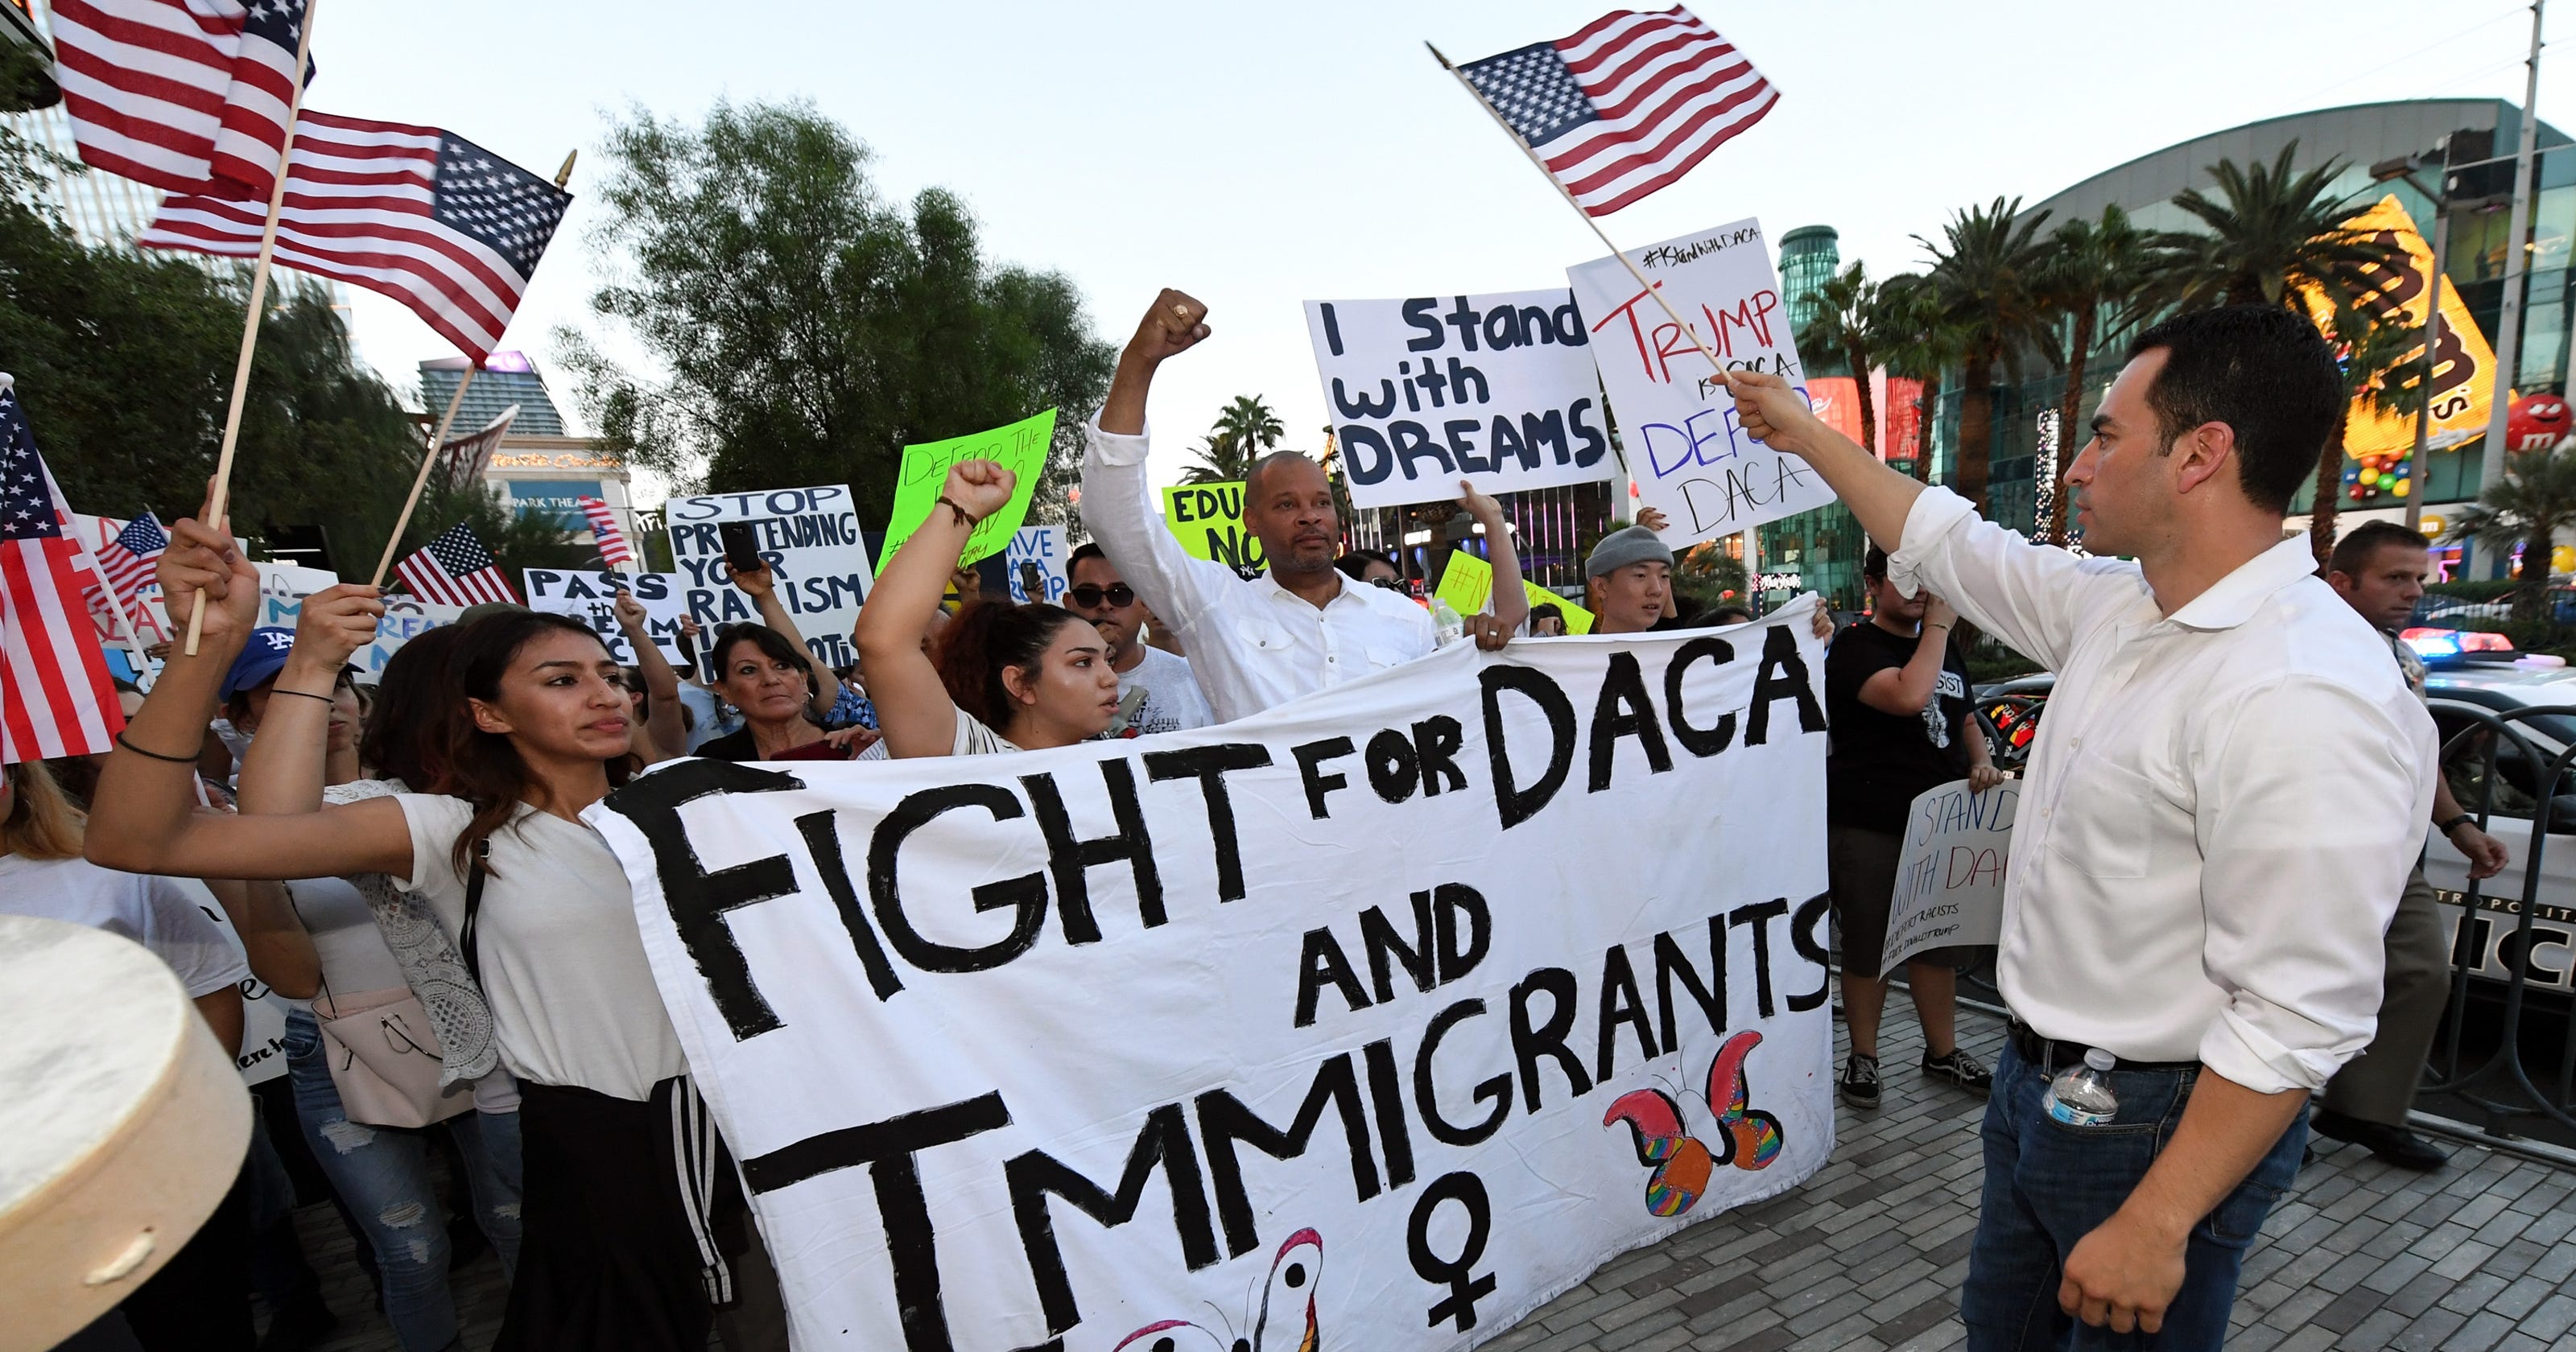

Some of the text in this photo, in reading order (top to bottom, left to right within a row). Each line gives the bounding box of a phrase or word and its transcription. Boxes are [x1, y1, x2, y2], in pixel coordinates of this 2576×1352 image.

[1320, 295, 1589, 356] I Stand
[1592, 280, 1777, 384] TRUMP
[1331, 357, 1490, 419] with
[1010, 427, 1042, 457] THE
[1339, 398, 1606, 485] DREAMS
[512, 497, 547, 509] PARK
[675, 487, 842, 520] STOP
[1677, 455, 1811, 535] DACA
[671, 513, 857, 555] PRTENDING
[679, 551, 788, 587] YOR
[528, 570, 668, 600] PASS
[1477, 624, 1827, 831] DACA
[1918, 789, 2019, 847] STAND
[603, 714, 1468, 1043] FIGHT FOR
[1891, 846, 2008, 925] WITH DA
[1293, 882, 1492, 1028] AND
[2449, 913, 2576, 993] IC
[741, 890, 1831, 1352] IMMIGRANTS
